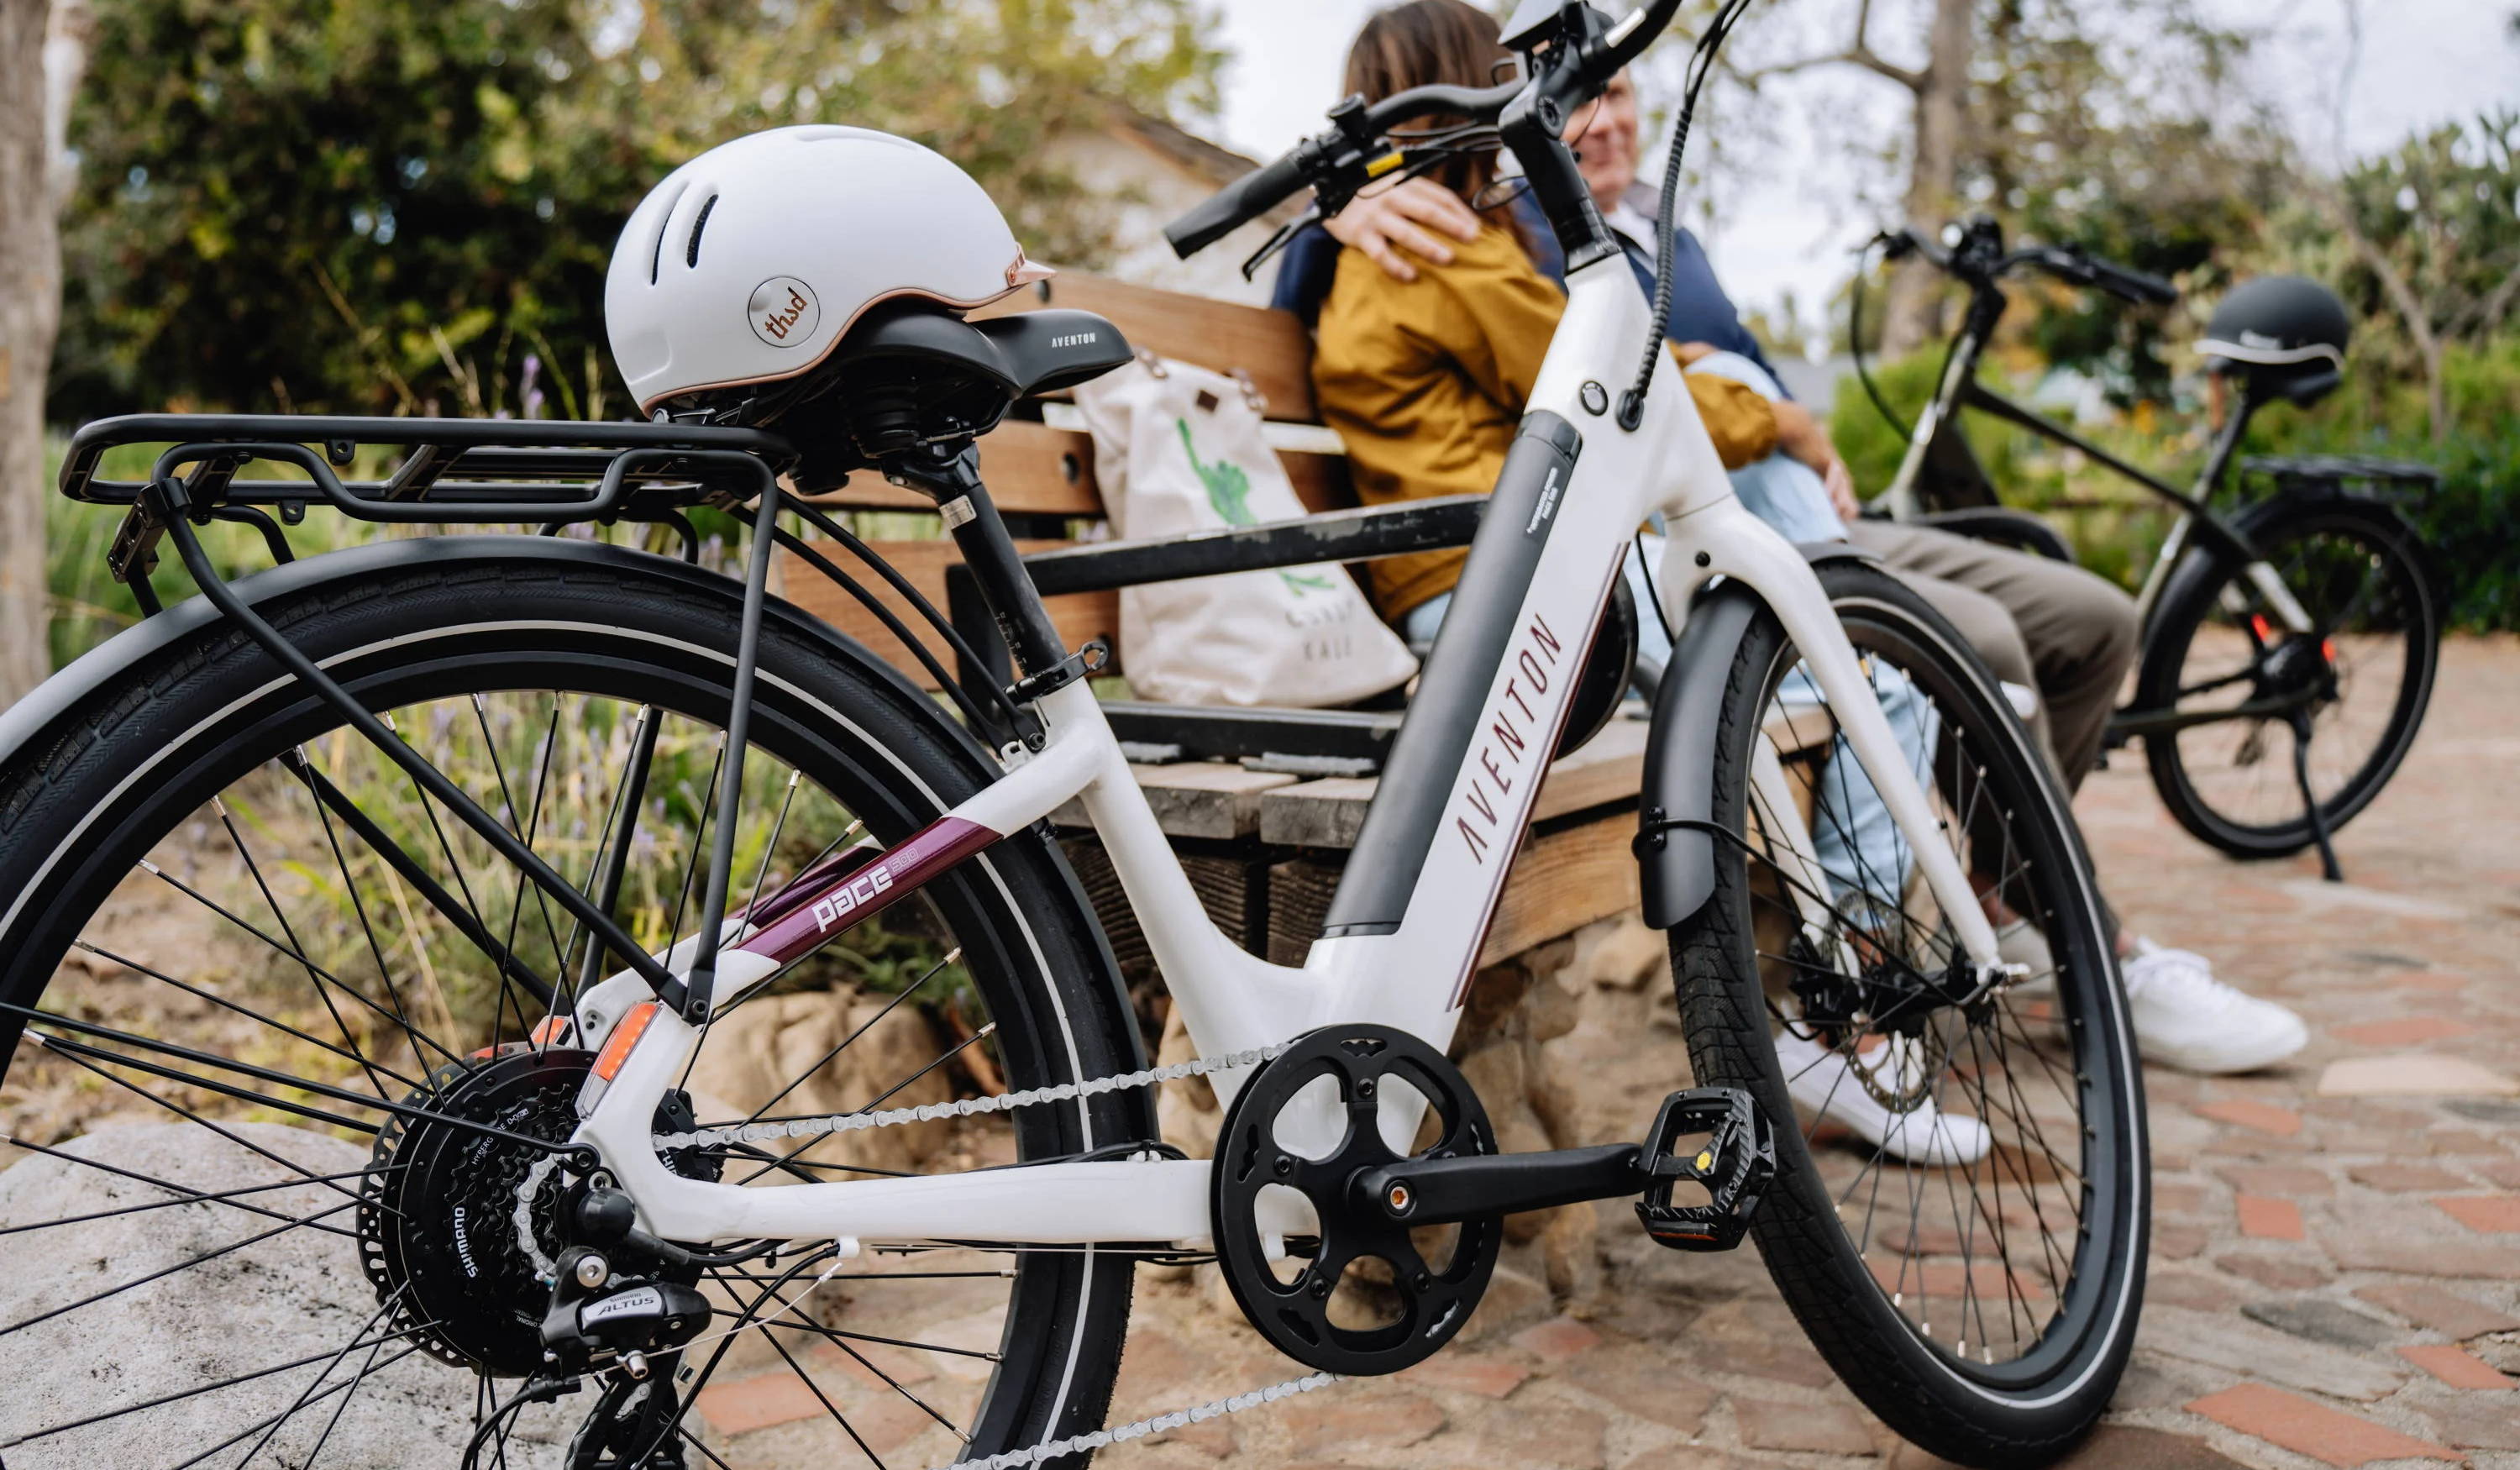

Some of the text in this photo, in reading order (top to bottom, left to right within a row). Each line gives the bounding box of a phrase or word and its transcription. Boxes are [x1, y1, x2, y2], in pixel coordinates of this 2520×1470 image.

[764, 286, 807, 339] thsd
[1052, 332, 1095, 349] AVENTON
[1457, 612, 1562, 865] AVENTON
[889, 847, 920, 873] 500
[454, 1207, 479, 1278] SHIMANO
[597, 1296, 654, 1316] ALTUS
